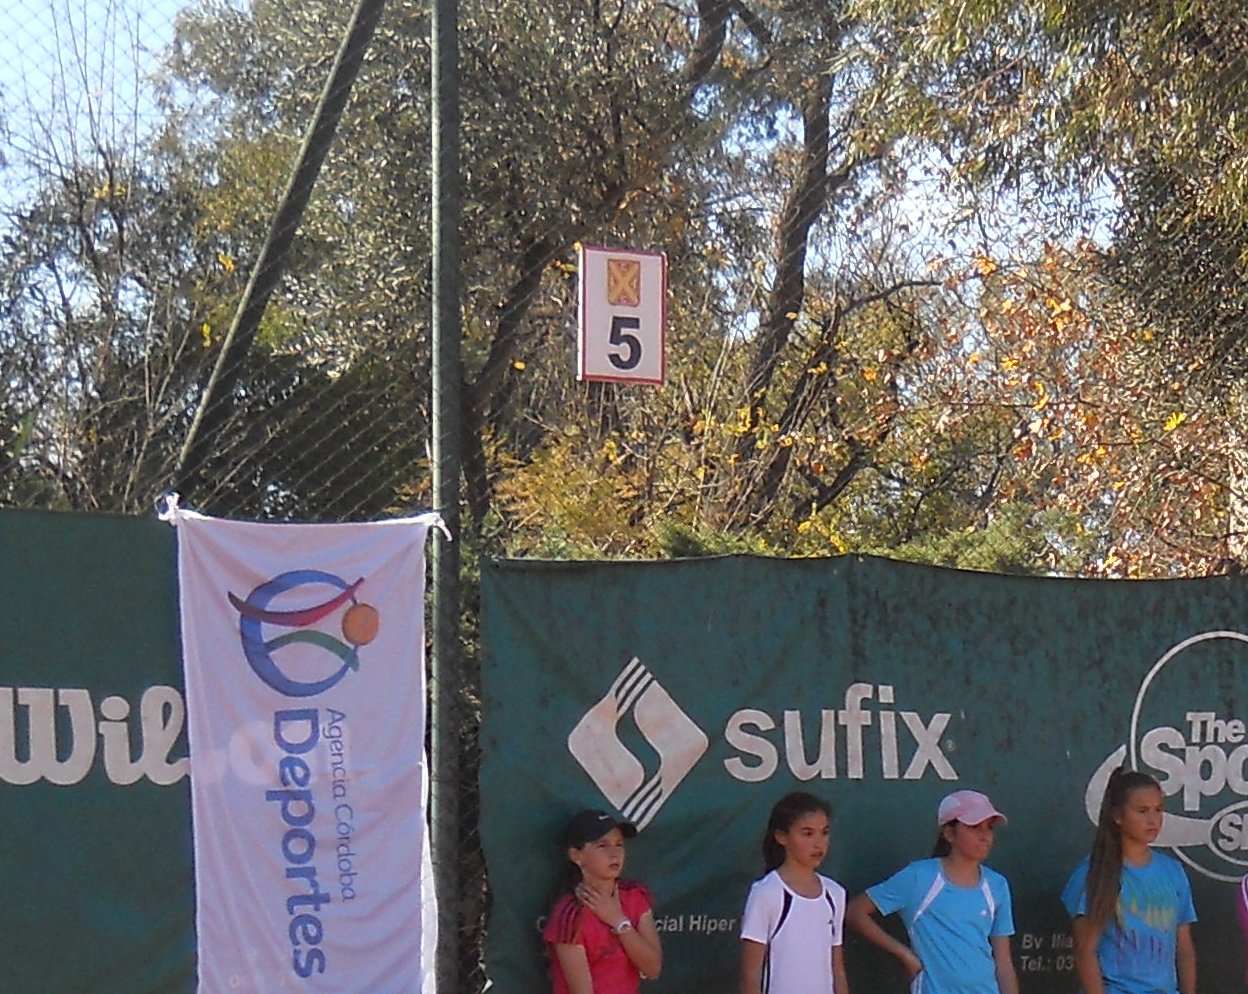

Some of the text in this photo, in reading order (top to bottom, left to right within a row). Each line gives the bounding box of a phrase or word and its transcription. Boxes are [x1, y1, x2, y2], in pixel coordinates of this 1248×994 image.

[607, 315, 642, 371] 5
[723, 682, 959, 783] sufix
[1186, 711, 1246, 744] The
[265, 708, 331, 979] Deportes
[322, 708, 358, 903] Agencia Córdoba
[689, 914, 736, 935] Hiper
